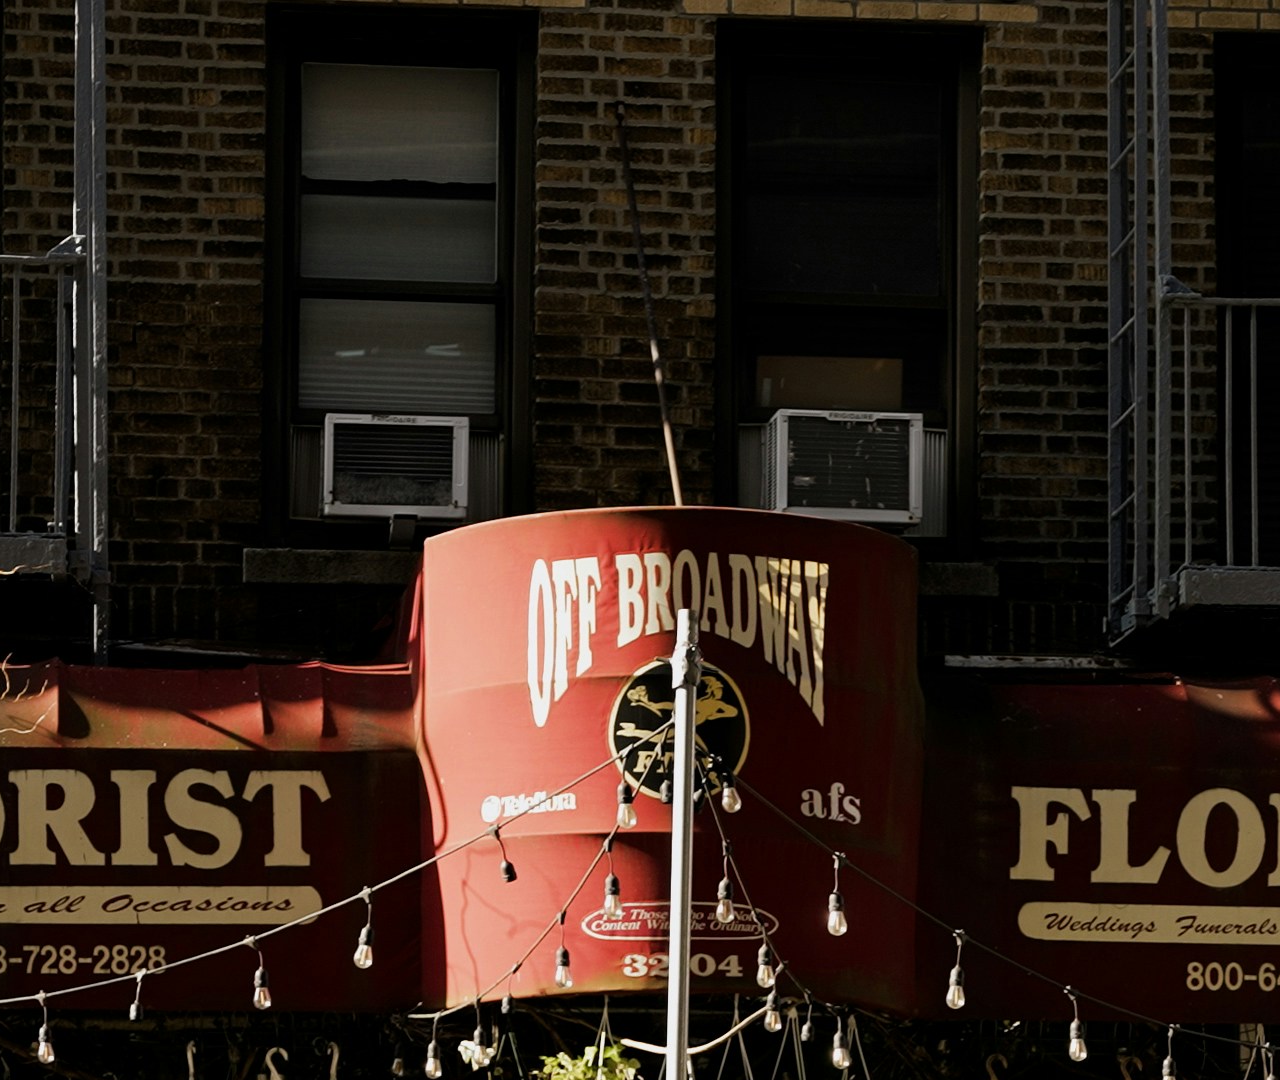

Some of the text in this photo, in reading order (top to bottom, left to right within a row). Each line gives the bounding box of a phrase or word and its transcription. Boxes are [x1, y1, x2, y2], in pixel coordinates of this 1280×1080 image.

[527, 549, 830, 728] OFF BROADWAY
[500, 791, 577, 817] Teleflora
[801, 782, 861, 825] afs
[23, 895, 86, 914] all
[101, 894, 295, 914] Occasions
[630, 909, 669, 920] Those
[591, 920, 641, 932] Content
[647, 919, 671, 930] Wit
[1044, 912, 1157, 939] Weddings
[1175, 915, 1280, 937] Funerals
